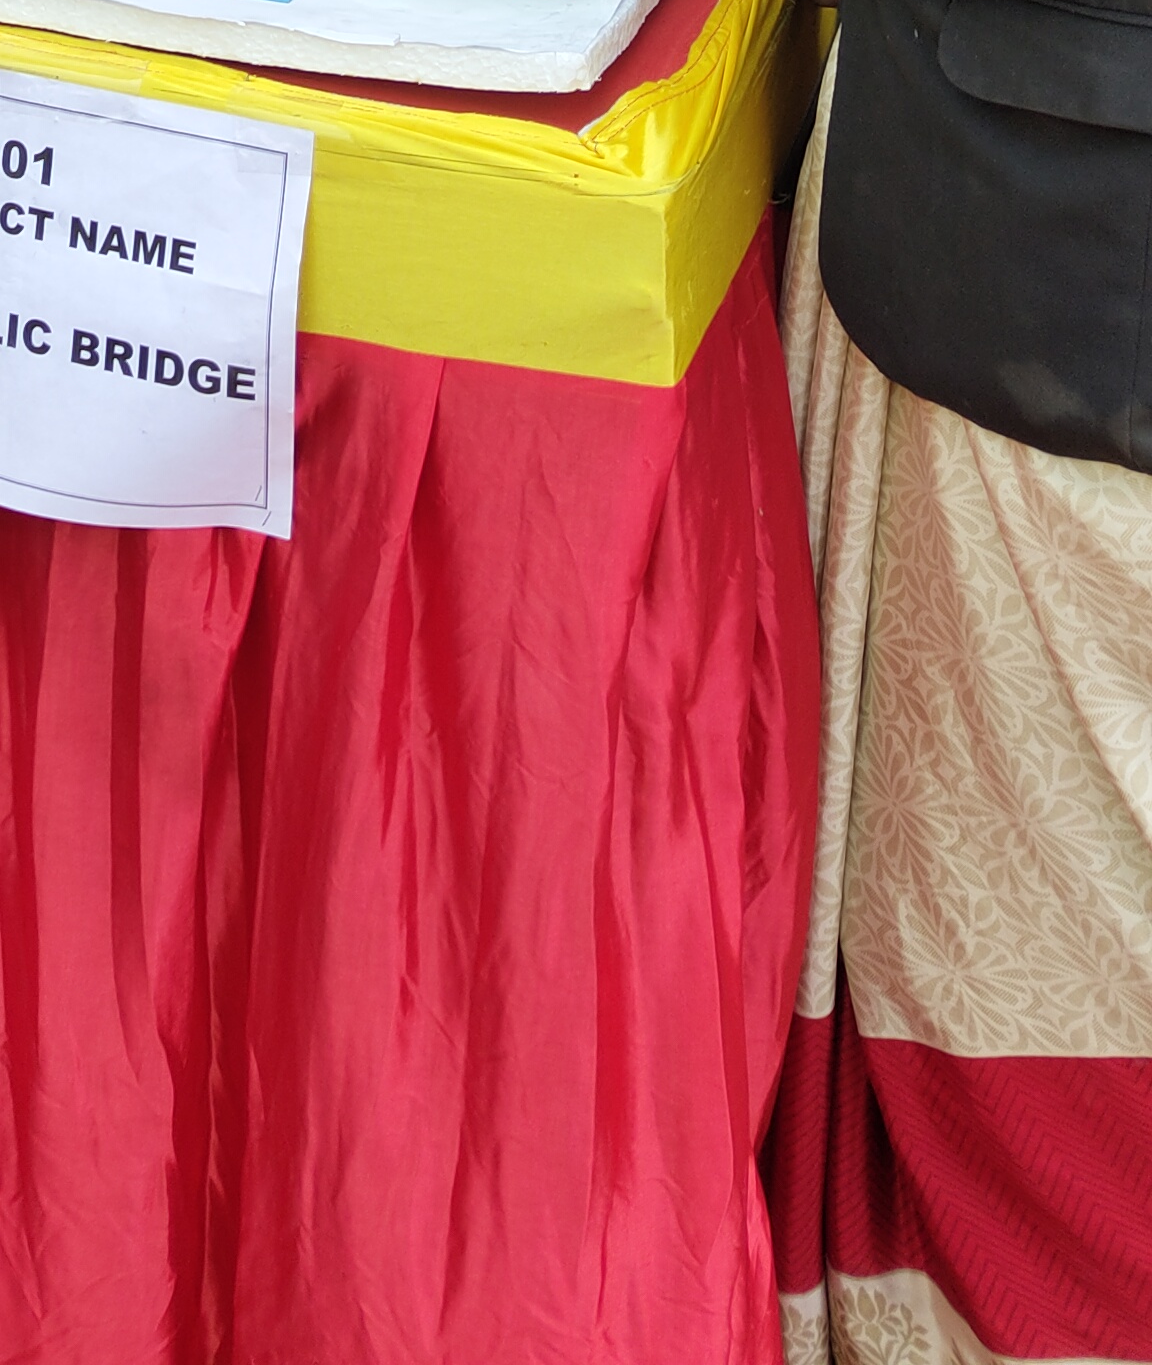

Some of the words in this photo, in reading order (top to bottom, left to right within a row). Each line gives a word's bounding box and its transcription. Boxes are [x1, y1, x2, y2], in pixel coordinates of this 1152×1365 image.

[0, 139, 55, 187] 01
[68, 216, 198, 275] NAME
[70, 328, 257, 401] BRIDGE
